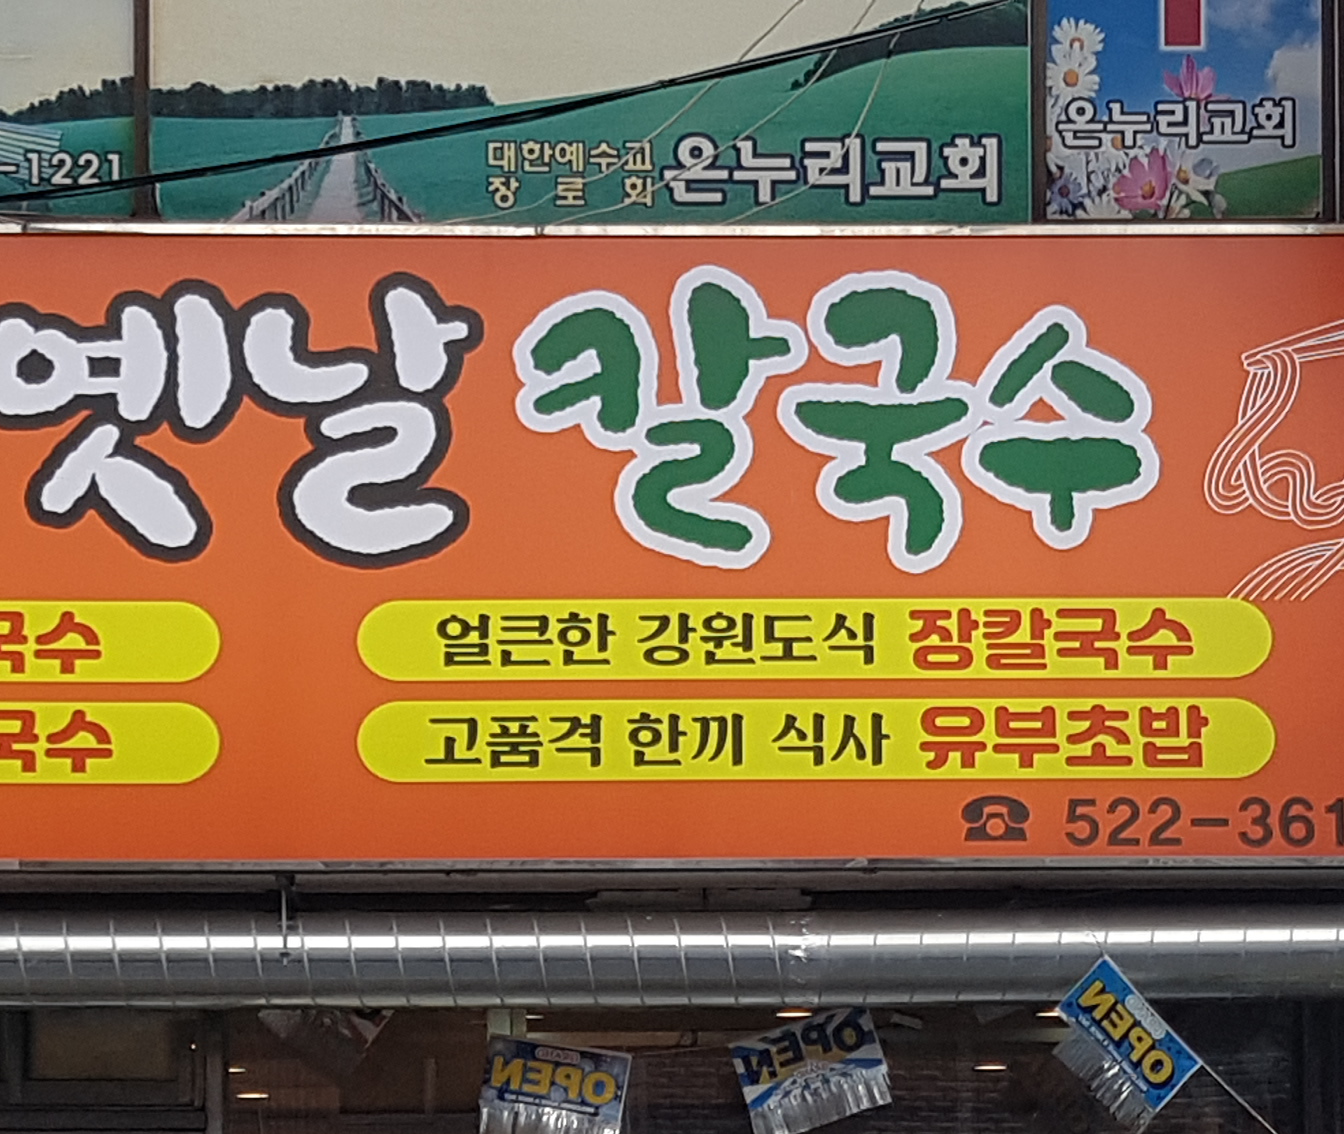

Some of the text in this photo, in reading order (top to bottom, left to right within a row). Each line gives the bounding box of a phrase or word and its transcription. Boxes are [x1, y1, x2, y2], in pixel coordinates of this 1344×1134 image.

[1059, 99, 1296, 147] 온누리교회
[487, 135, 1001, 204] 대한예수교 온누리교회
[513, 264, 1159, 573] 칼국수
[436, 607, 1196, 671] 얼큰한 강원도식 장칼국수
[424, 704, 1208, 769] 고품격 한끼 식사 유부초밥
